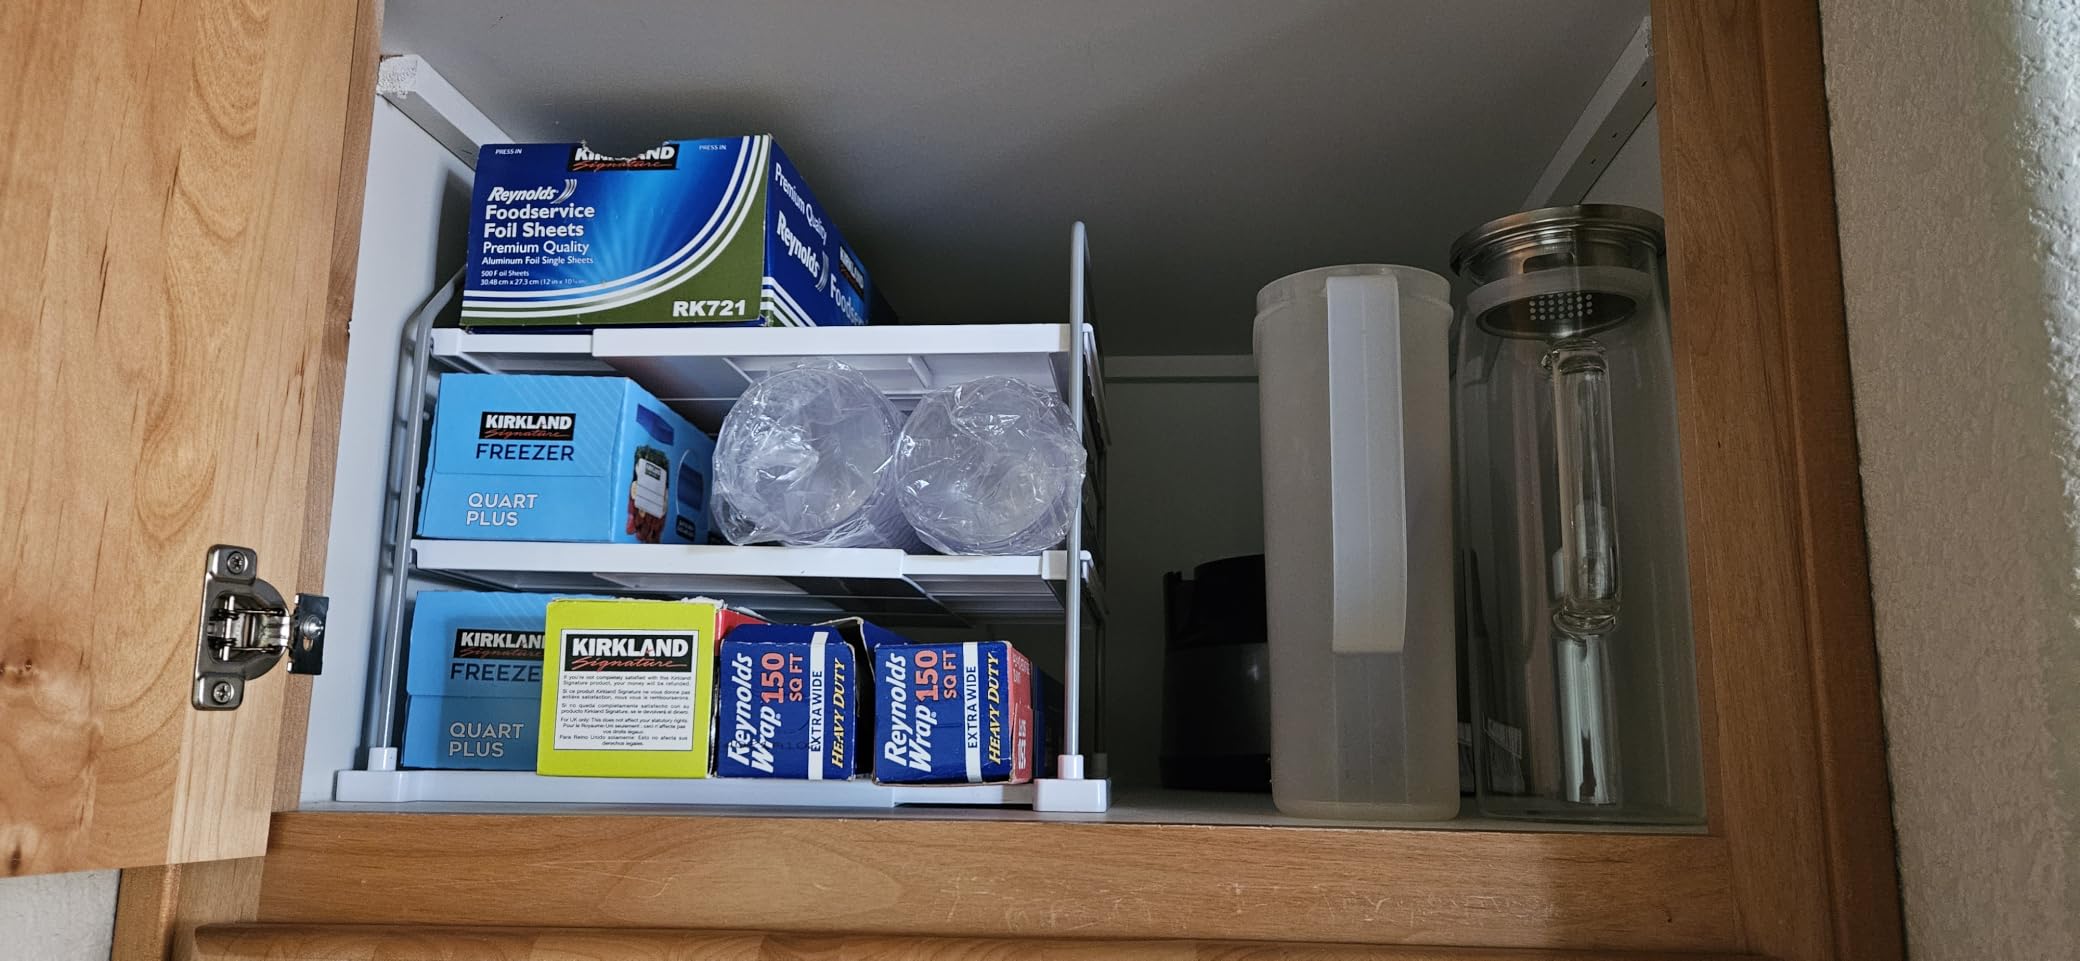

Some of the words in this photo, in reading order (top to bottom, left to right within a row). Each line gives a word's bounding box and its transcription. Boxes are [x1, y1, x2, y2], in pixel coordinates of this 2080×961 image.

[487, 186, 557, 204] Reynolds
[775, 162, 805, 217] Premium
[805, 204, 827, 246] Quality
[485, 203, 595, 220] Foodservice
[483, 223, 517, 238] Foil
[522, 222, 584, 237] Sheets
[483, 241, 539, 254] Premium
[543, 241, 589, 256] Quality
[777, 210, 820, 278] Reynolds
[481, 256, 523, 265] Aluminum
[525, 256, 540, 264] Foil
[542, 256, 565, 266] Single
[567, 256, 593, 264] Sheets
[672, 300, 746, 317] RK721
[485, 414, 572, 429] KIRKLAND
[484, 428, 570, 439] Signature
[476, 443, 574, 461] FREEZER
[468, 492, 538, 509] QUART
[466, 510, 518, 526] PLUS
[572, 638, 688, 657] KIRKLAND
[571, 656, 687, 672] Signature
[790, 653, 803, 673] FT
[943, 650, 957, 670] FT
[450, 663, 542, 682] FREEZE
[761, 653, 785, 704] 150
[915, 650, 938, 701] 150
[988, 652, 999, 704] DUTY
[789, 678, 803, 701] SQ
[812, 671, 822, 703] WIDE
[833, 657, 846, 709] DUTY
[943, 677, 957, 699] SQ
[966, 666, 977, 703] WIDE
[728, 653, 757, 766] Reynolds
[885, 653, 913, 767] Reynolds
[449, 722, 524, 739] QUART
[811, 703, 822, 752] EXTRA
[967, 703, 977, 748] EXTRA
[989, 706, 1001, 765] HEAVY
[832, 709, 844, 768] HEAVY
[449, 741, 504, 757] PLUS
